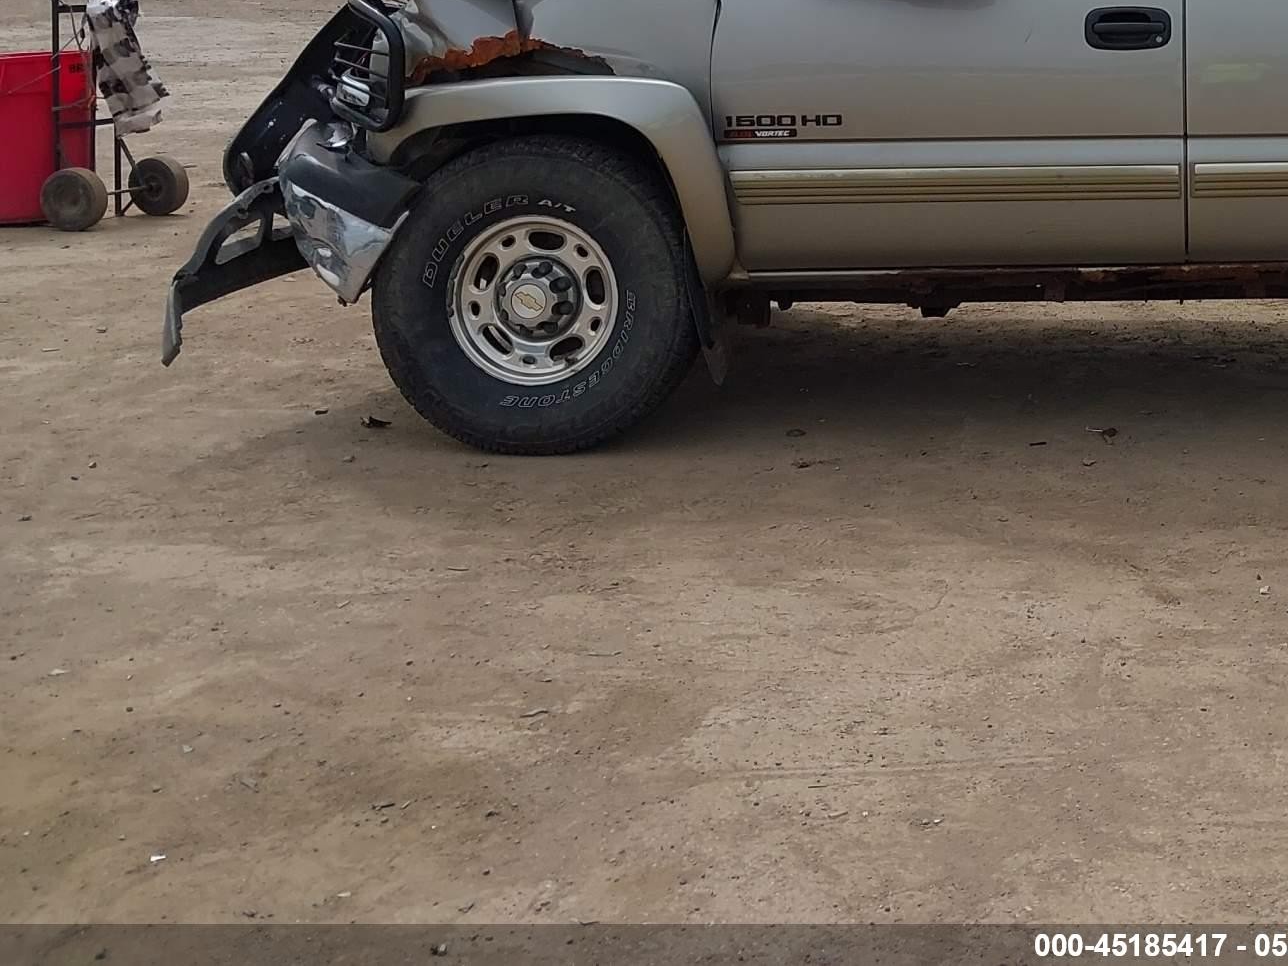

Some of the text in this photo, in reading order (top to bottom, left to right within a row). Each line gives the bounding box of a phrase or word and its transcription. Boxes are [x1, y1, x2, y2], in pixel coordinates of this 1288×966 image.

[726, 115, 843, 128] 1500 HD
[422, 194, 577, 288] DUELER A/T
[499, 289, 637, 408] BRIDGESTONE
